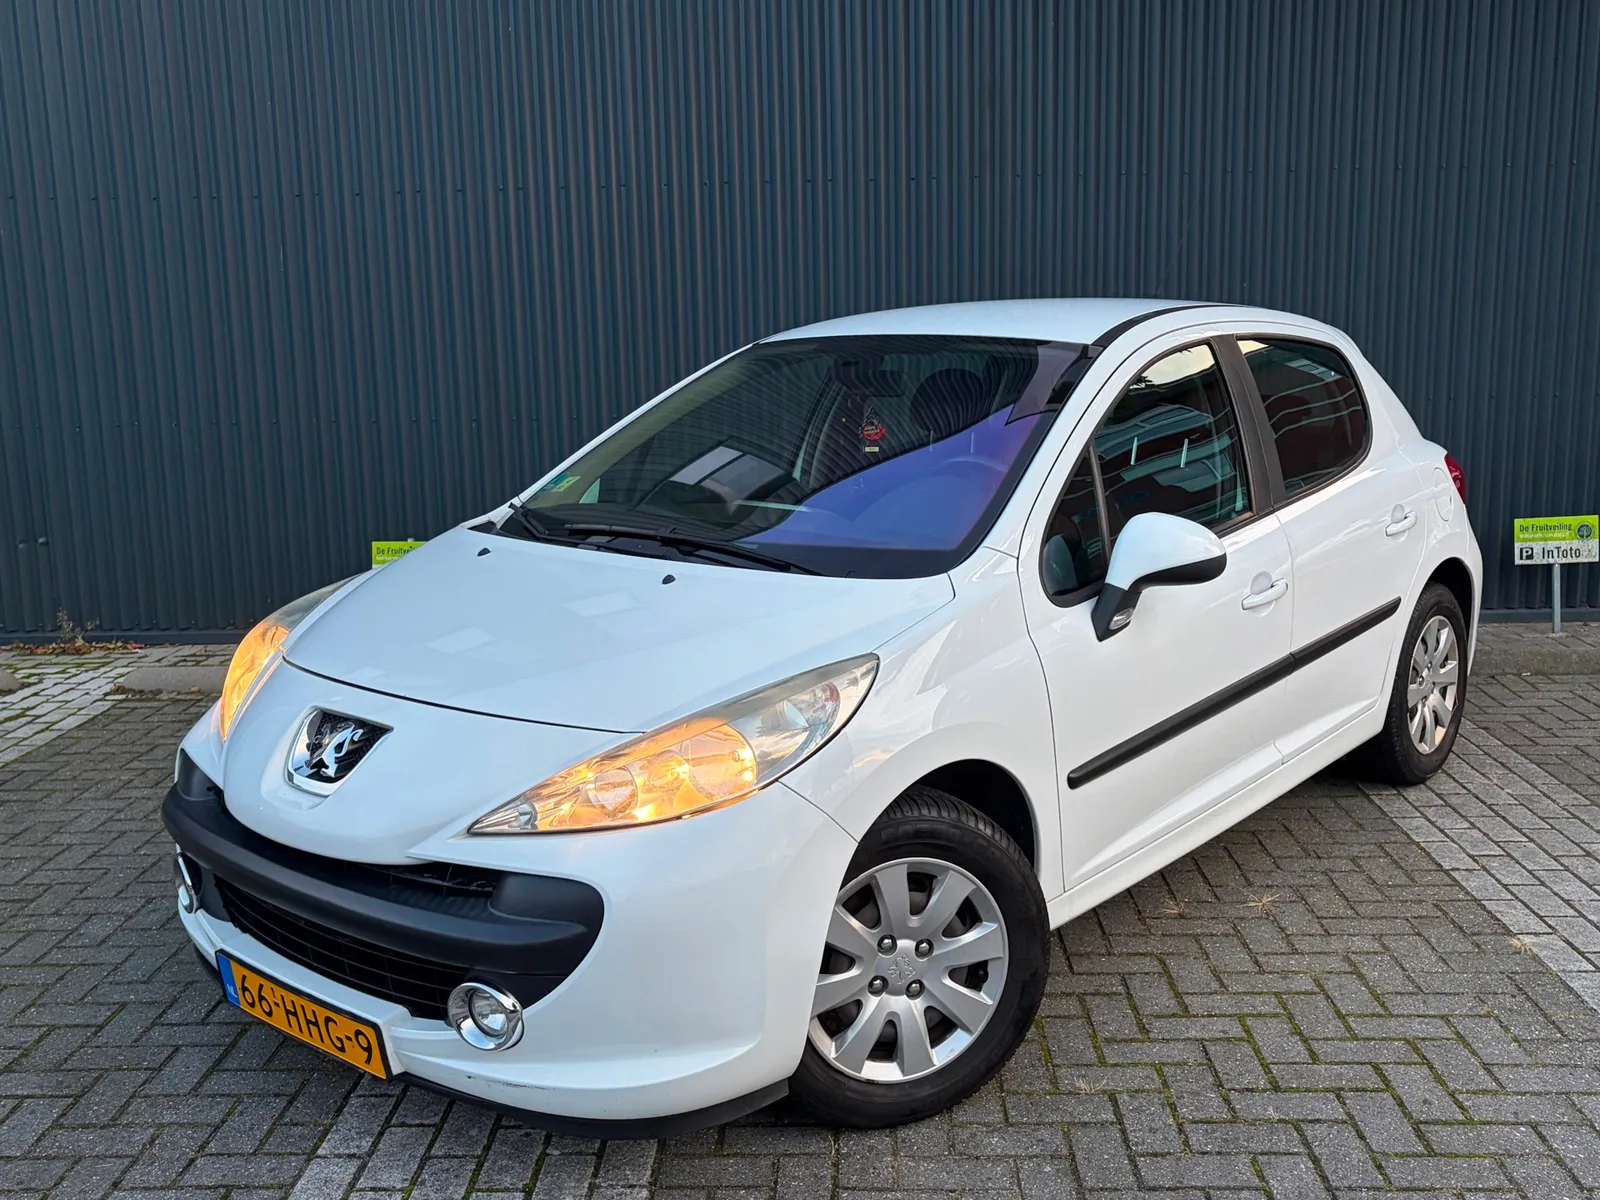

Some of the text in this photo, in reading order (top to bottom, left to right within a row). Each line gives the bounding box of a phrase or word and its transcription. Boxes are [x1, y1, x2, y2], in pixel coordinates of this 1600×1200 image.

[1532, 523, 1573, 532] Fruitveiling
[1521, 547, 1581, 560] P InToto
[226, 974, 373, 1066] NL 66-HHG-9
